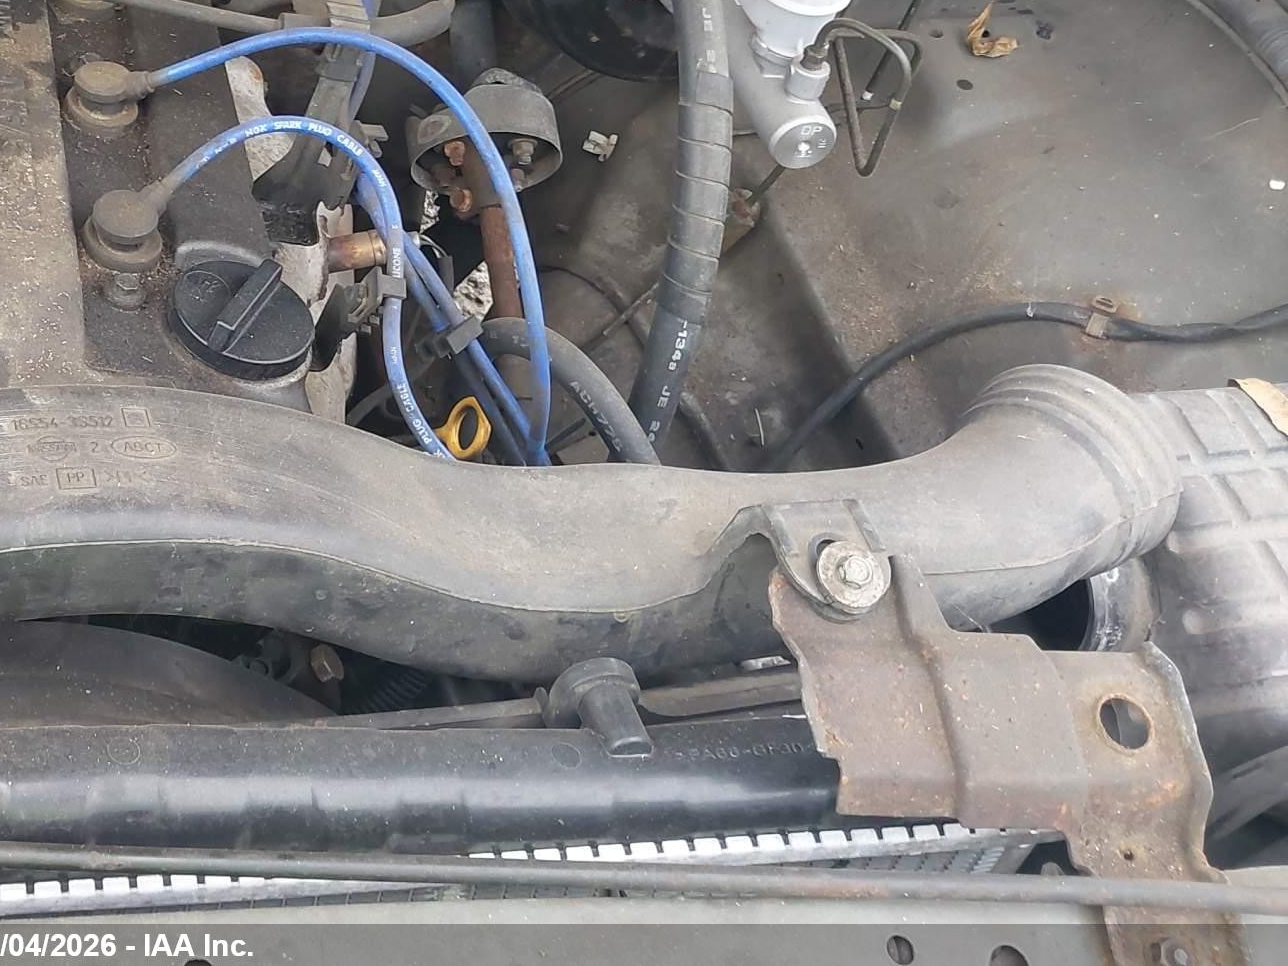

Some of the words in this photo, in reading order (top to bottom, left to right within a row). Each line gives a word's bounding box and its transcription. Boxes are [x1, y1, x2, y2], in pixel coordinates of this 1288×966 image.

[273, 120, 302, 131] SPARK
[308, 122, 333, 136] PLUG
[337, 134, 364, 156] CABLE
[657, 385, 671, 408] JE
[67, 472, 85, 483] PP
